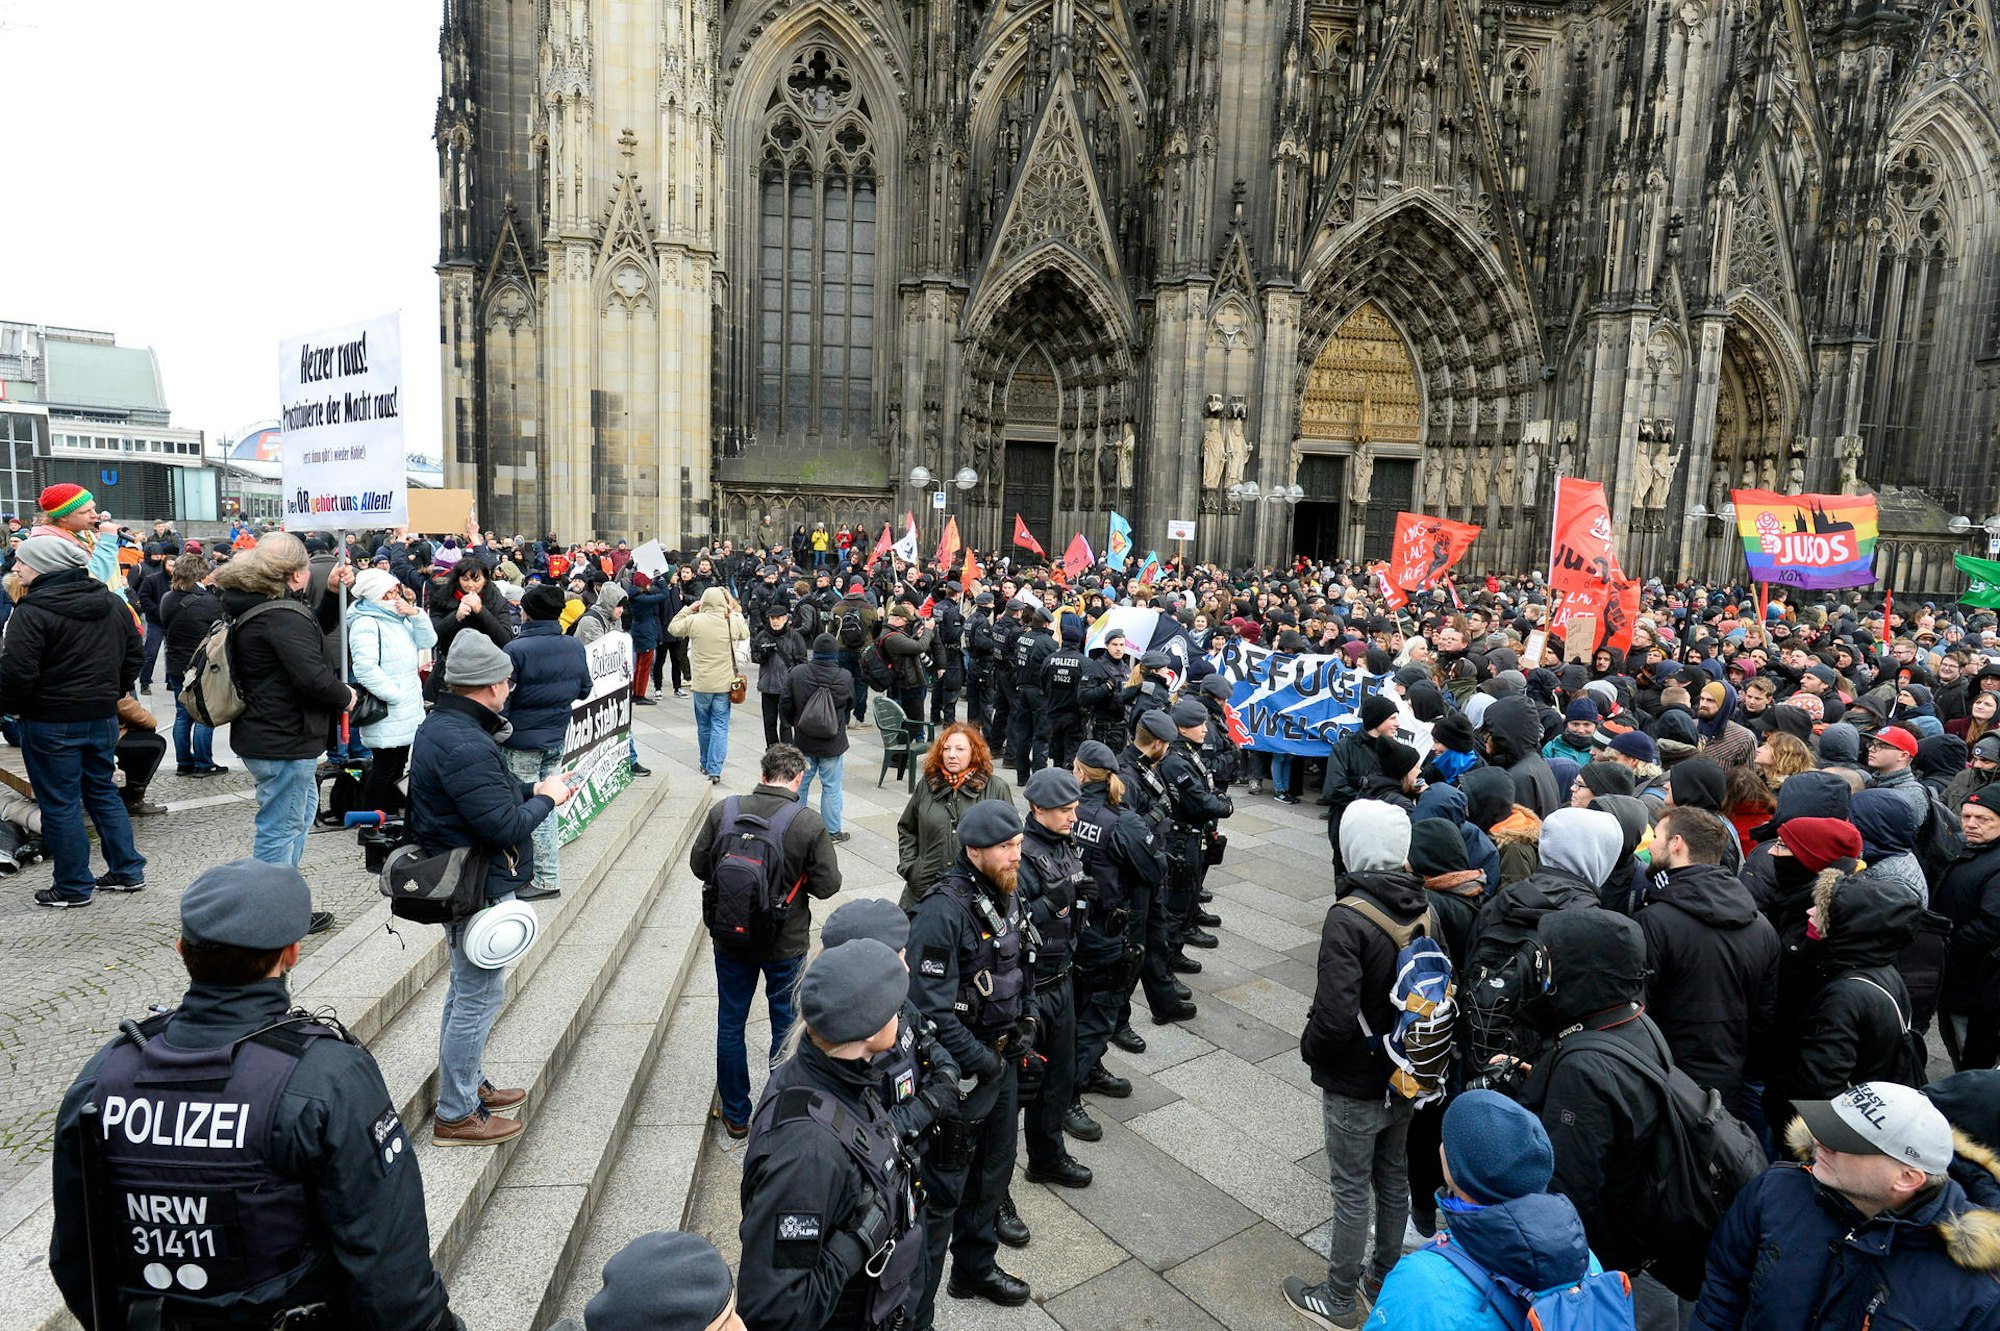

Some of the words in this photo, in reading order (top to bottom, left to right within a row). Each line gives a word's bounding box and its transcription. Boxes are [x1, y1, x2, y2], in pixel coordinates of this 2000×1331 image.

[301, 343, 334, 384] Hetzer
[337, 330, 368, 377] raus!
[326, 395, 341, 425] der
[344, 390, 370, 423] Macht
[374, 385, 398, 419] raus!
[102, 469, 118, 486] U
[297, 486, 310, 514] ÖR
[310, 493, 339, 515] gehört
[340, 495, 358, 512] uns
[361, 490, 393, 511] Allen!
[1050, 657, 1079, 668] POLIZEI
[594, 698, 618, 741] steht
[1559, 1022, 1584, 1039] Canon
[102, 1095, 250, 1149] POLIZEI
[126, 1192, 208, 1225] NRW
[132, 1226, 216, 1258] 31411
